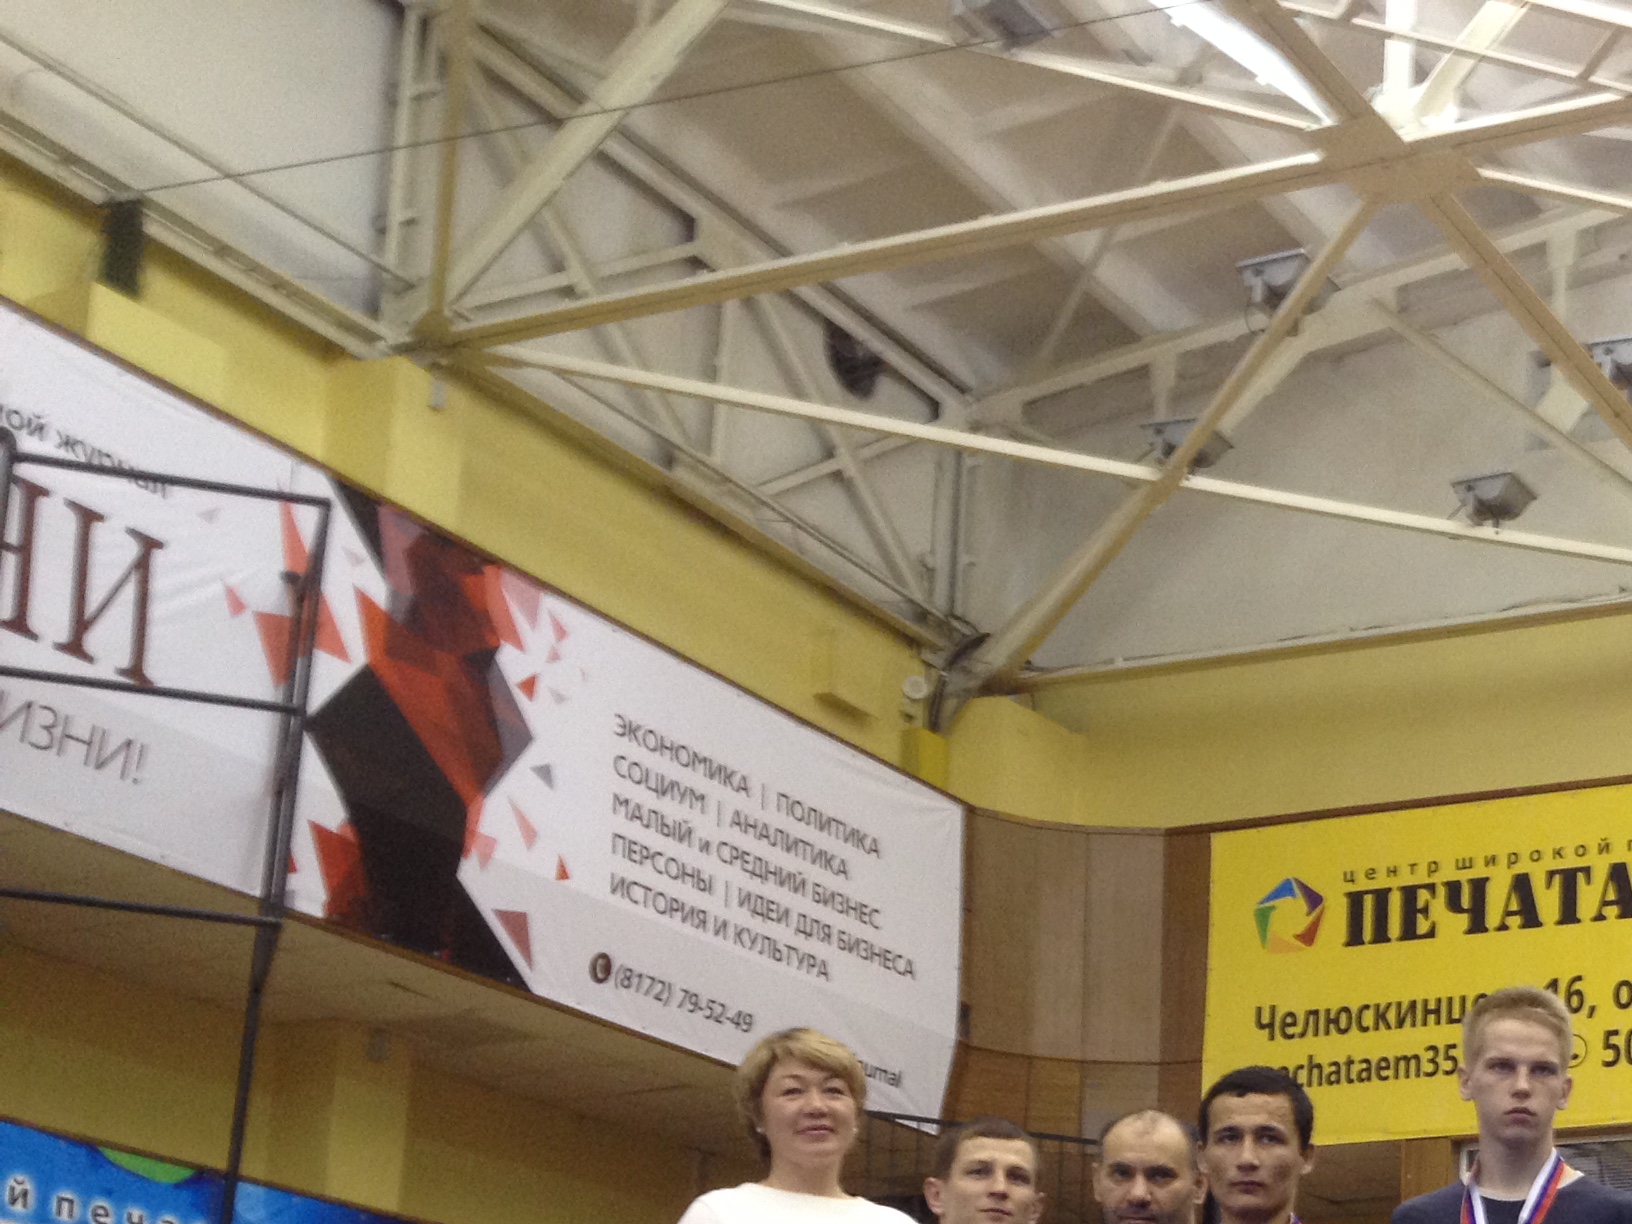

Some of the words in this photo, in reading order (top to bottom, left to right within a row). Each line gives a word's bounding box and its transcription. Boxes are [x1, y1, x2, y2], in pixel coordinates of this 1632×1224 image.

[0, 404, 47, 442] ой
[612, 712, 749, 798] ЭКОНОМИКА
[775, 791, 881, 859] ПОЛИТИКА
[613, 754, 706, 815] СОЦИУМ
[729, 811, 849, 881] АНАЛИТИКА
[610, 832, 715, 895] ПЕРСОНЫ
[737, 888, 790, 928] ИДЕИ
[794, 912, 833, 947] ДЛЯ
[836, 929, 916, 981] БИЗНЕСА
[611, 792, 694, 848] МАЛЫЙ
[715, 841, 806, 896] СРЕДНИЙ
[811, 882, 881, 930] БИЗНЕС
[1342, 858, 1440, 885] центр
[1455, 837, 1612, 873] широкой
[610, 872, 708, 933] ИСТОРИЯ
[713, 915, 728, 942] И
[733, 921, 831, 983] КУЛЬТУРА
[613, 963, 673, 1008] (8172)
[676, 987, 755, 1034] 79-52-49
[1254, 992, 1484, 1042] Челюскинц
